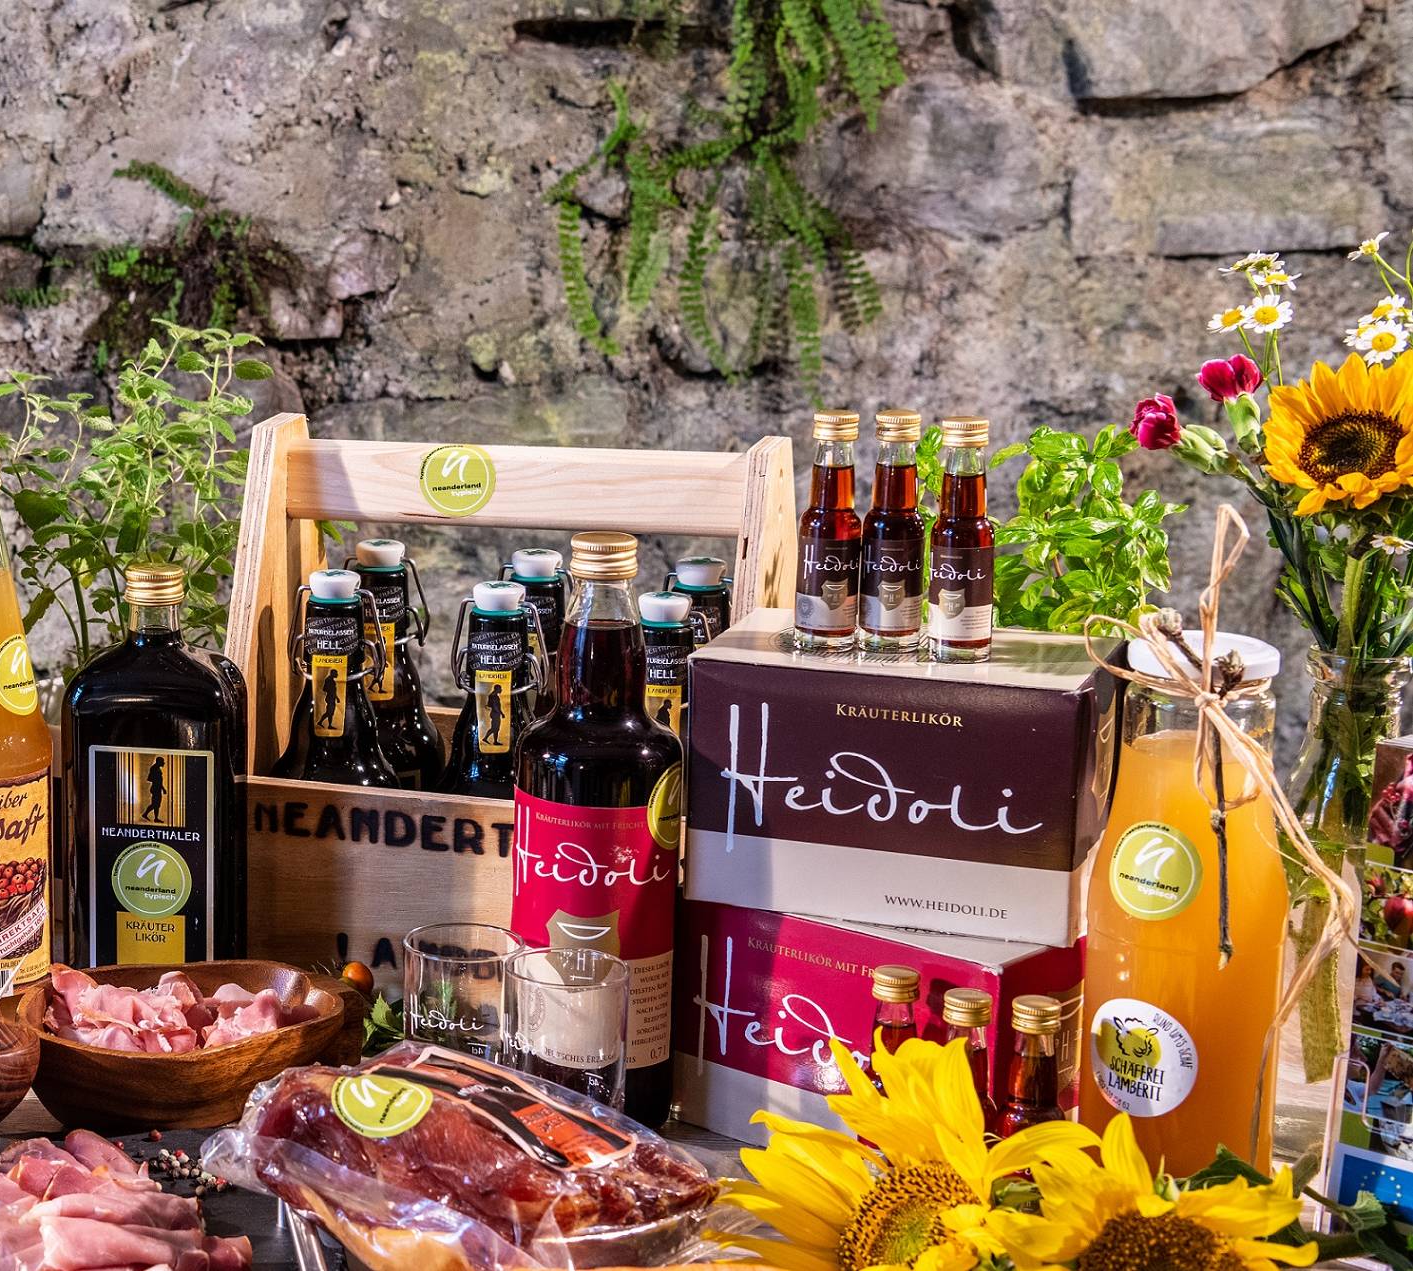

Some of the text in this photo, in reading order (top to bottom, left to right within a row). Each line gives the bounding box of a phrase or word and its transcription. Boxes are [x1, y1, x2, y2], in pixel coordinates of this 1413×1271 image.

[432, 483, 481, 491] neanderland
[804, 544, 859, 579] Heidoli
[862, 544, 921, 578] Heidoli
[317, 640, 342, 650] HELL
[480, 655, 508, 665] HELL
[650, 669, 677, 679] HELL
[720, 701, 1044, 853] Heidoli
[102, 827, 201, 841] NEANDERTHALER
[253, 801, 514, 858] NEANDERT
[515, 804, 670, 896] Heidoli
[125, 885, 176, 894] neanderland
[1119, 872, 1179, 893] neanderland
[884, 894, 1009, 920] WWW.HEIDOLI.DE
[126, 920, 175, 932] KRÄUTER
[135, 932, 166, 943] LIKÖR
[835, 958, 860, 974] MIT
[409, 993, 485, 1035] Heidoli
[692, 934, 871, 1078] Heido
[649, 1046, 666, 1060] 0,7l
